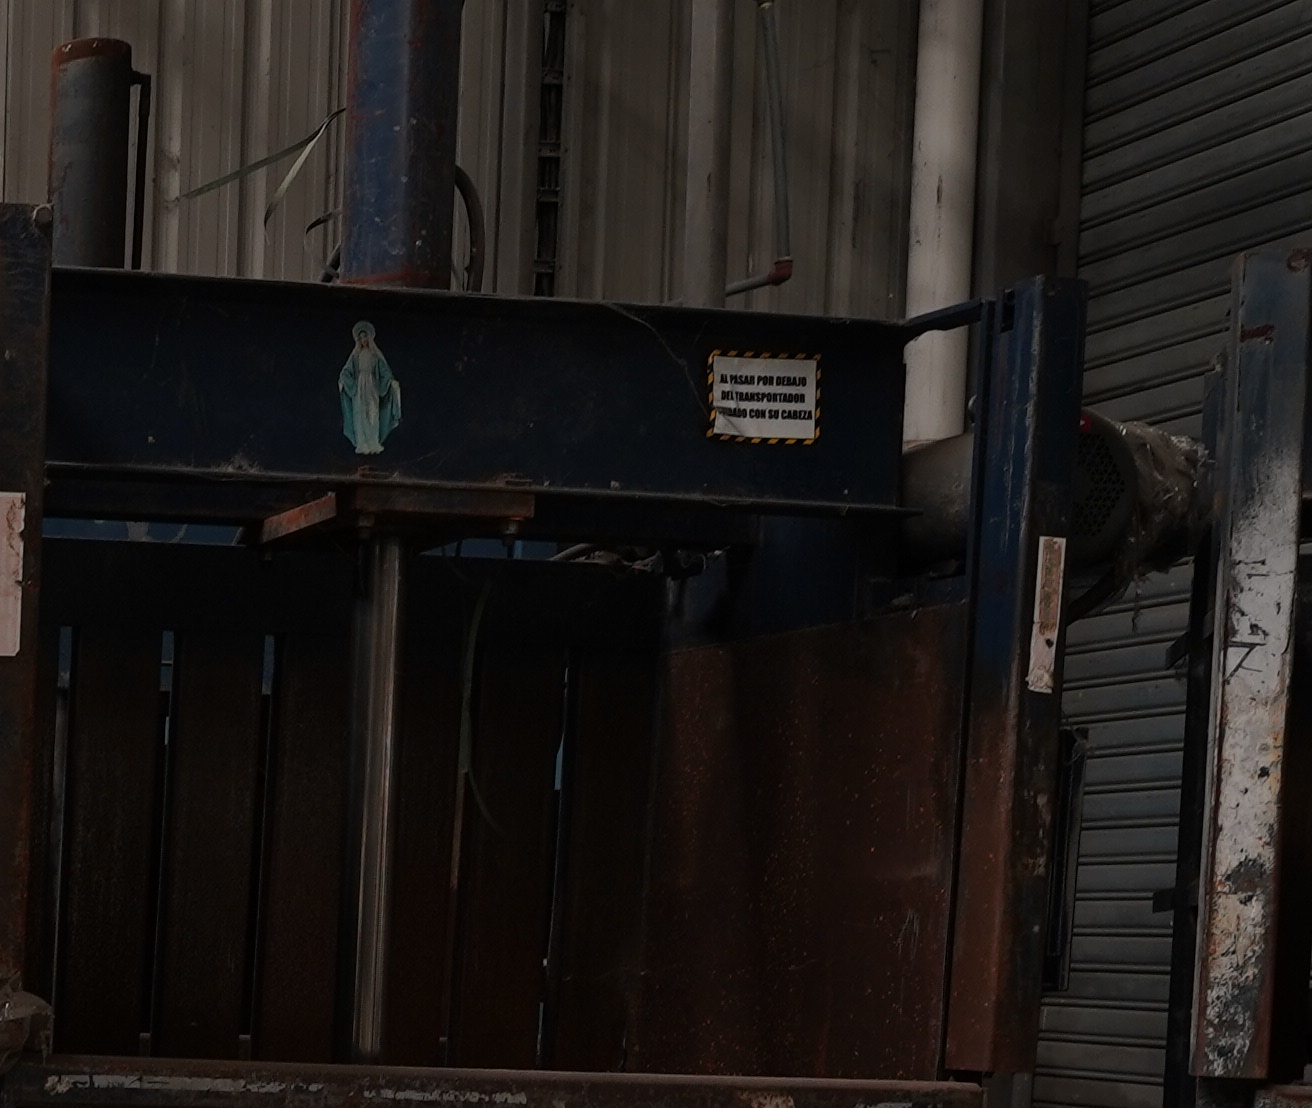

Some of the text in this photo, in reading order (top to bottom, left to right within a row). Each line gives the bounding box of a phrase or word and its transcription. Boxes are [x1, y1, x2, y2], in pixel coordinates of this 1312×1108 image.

[720, 374, 807, 387] AL PASAR POR DEBAJO
[721, 391, 805, 403] DEL TRANSPORTADOR
[749, 409, 766, 419] CON
[768, 410, 779, 419] SU
[782, 410, 812, 420] CABEZA
